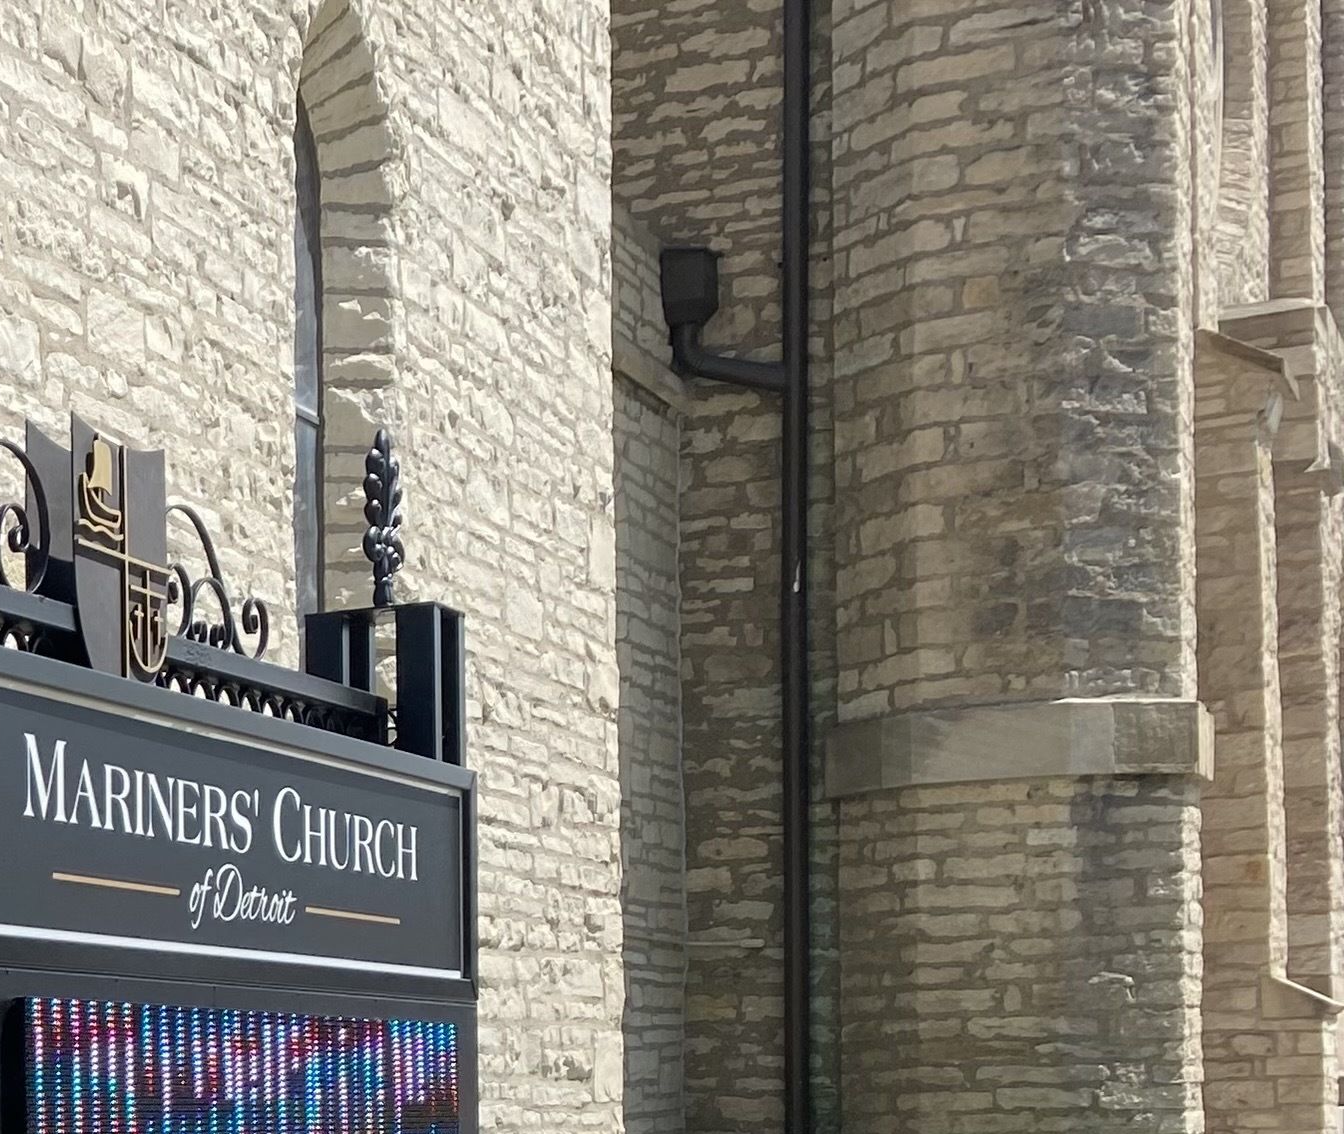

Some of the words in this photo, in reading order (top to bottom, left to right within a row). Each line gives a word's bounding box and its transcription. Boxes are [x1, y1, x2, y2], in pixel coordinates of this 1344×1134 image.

[273, 786, 419, 881] CHURCH
[188, 868, 214, 930] of
[213, 862, 298, 926] Detroit
